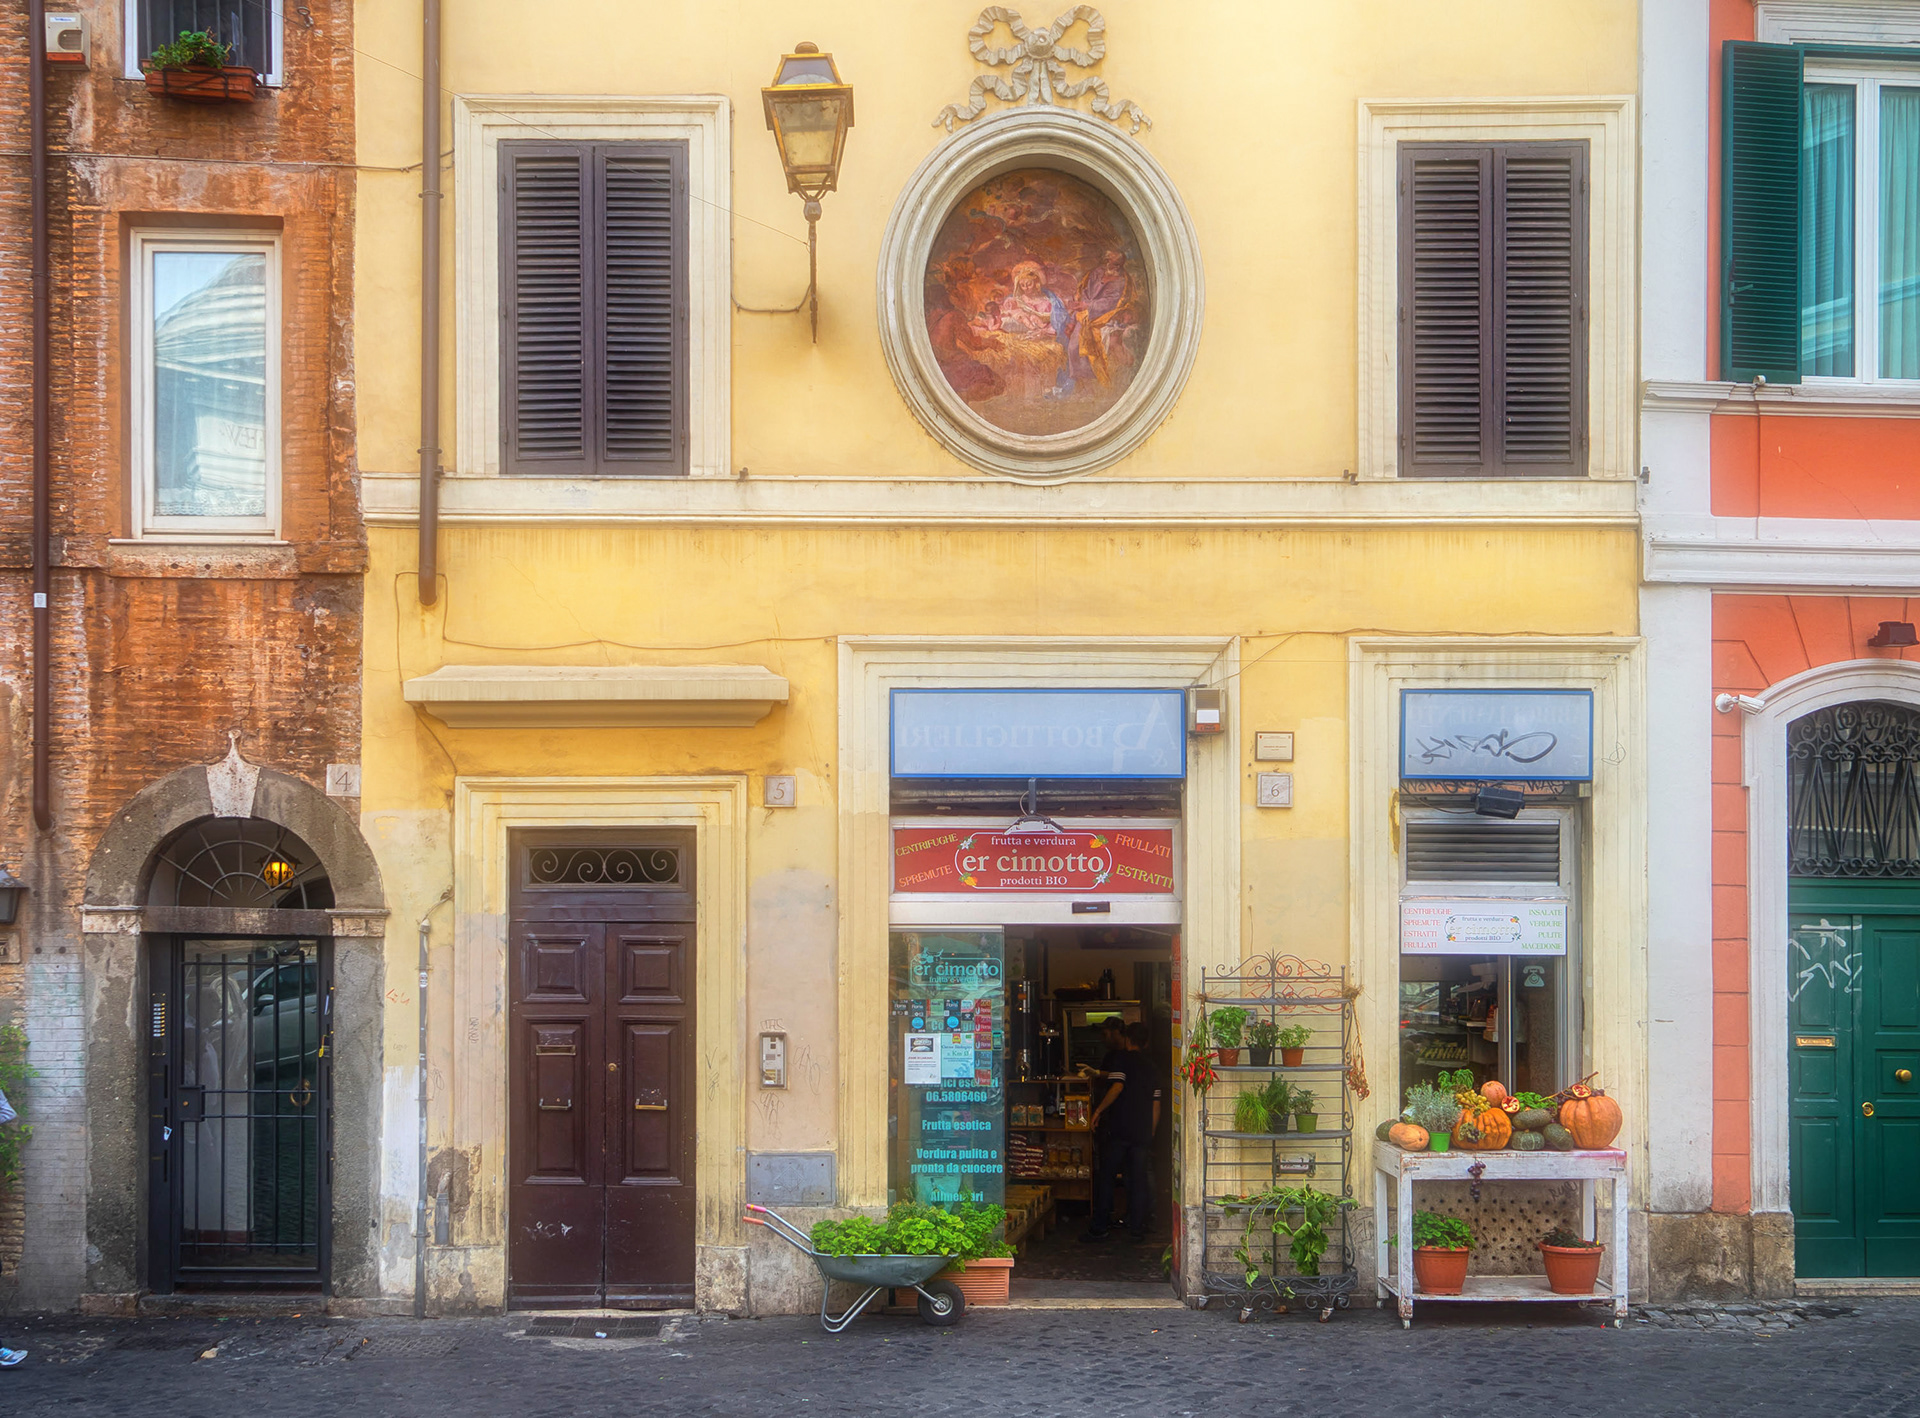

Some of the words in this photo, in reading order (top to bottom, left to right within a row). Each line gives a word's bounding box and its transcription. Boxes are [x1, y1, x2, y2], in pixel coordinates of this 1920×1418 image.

[335, 771, 353, 792] 4
[773, 781, 786, 800] 5
[1271, 783, 1280, 797] 6
[895, 832, 959, 857] CENTRIFUGHE
[991, 835, 1022, 846] frutta
[1025, 838, 1032, 846] e
[1034, 835, 1076, 846] verdura
[1114, 833, 1171, 858] FRULLATI
[962, 853, 991, 873] er
[996, 848, 1105, 873] cimotto
[898, 864, 953, 888] SPREMUTE
[1000, 875, 1043, 887] prodotti
[1046, 876, 1068, 886] BIO
[1115, 864, 1174, 889] ESTRATTI
[1448, 927, 1462, 935] er
[1464, 924, 1518, 935] cimotto
[913, 964, 931, 976] er
[935, 962, 999, 976] cimotto
[922, 1120, 952, 1130] Frutta
[954, 1120, 992, 1130] esotica
[916, 1148, 957, 1159] Verdura
[958, 1148, 989, 1160] pulita
[991, 1150, 998, 1159] e
[910, 1163, 944, 1174] pronta
[946, 1162, 960, 1174] da
[961, 1164, 1004, 1174] cuocere
